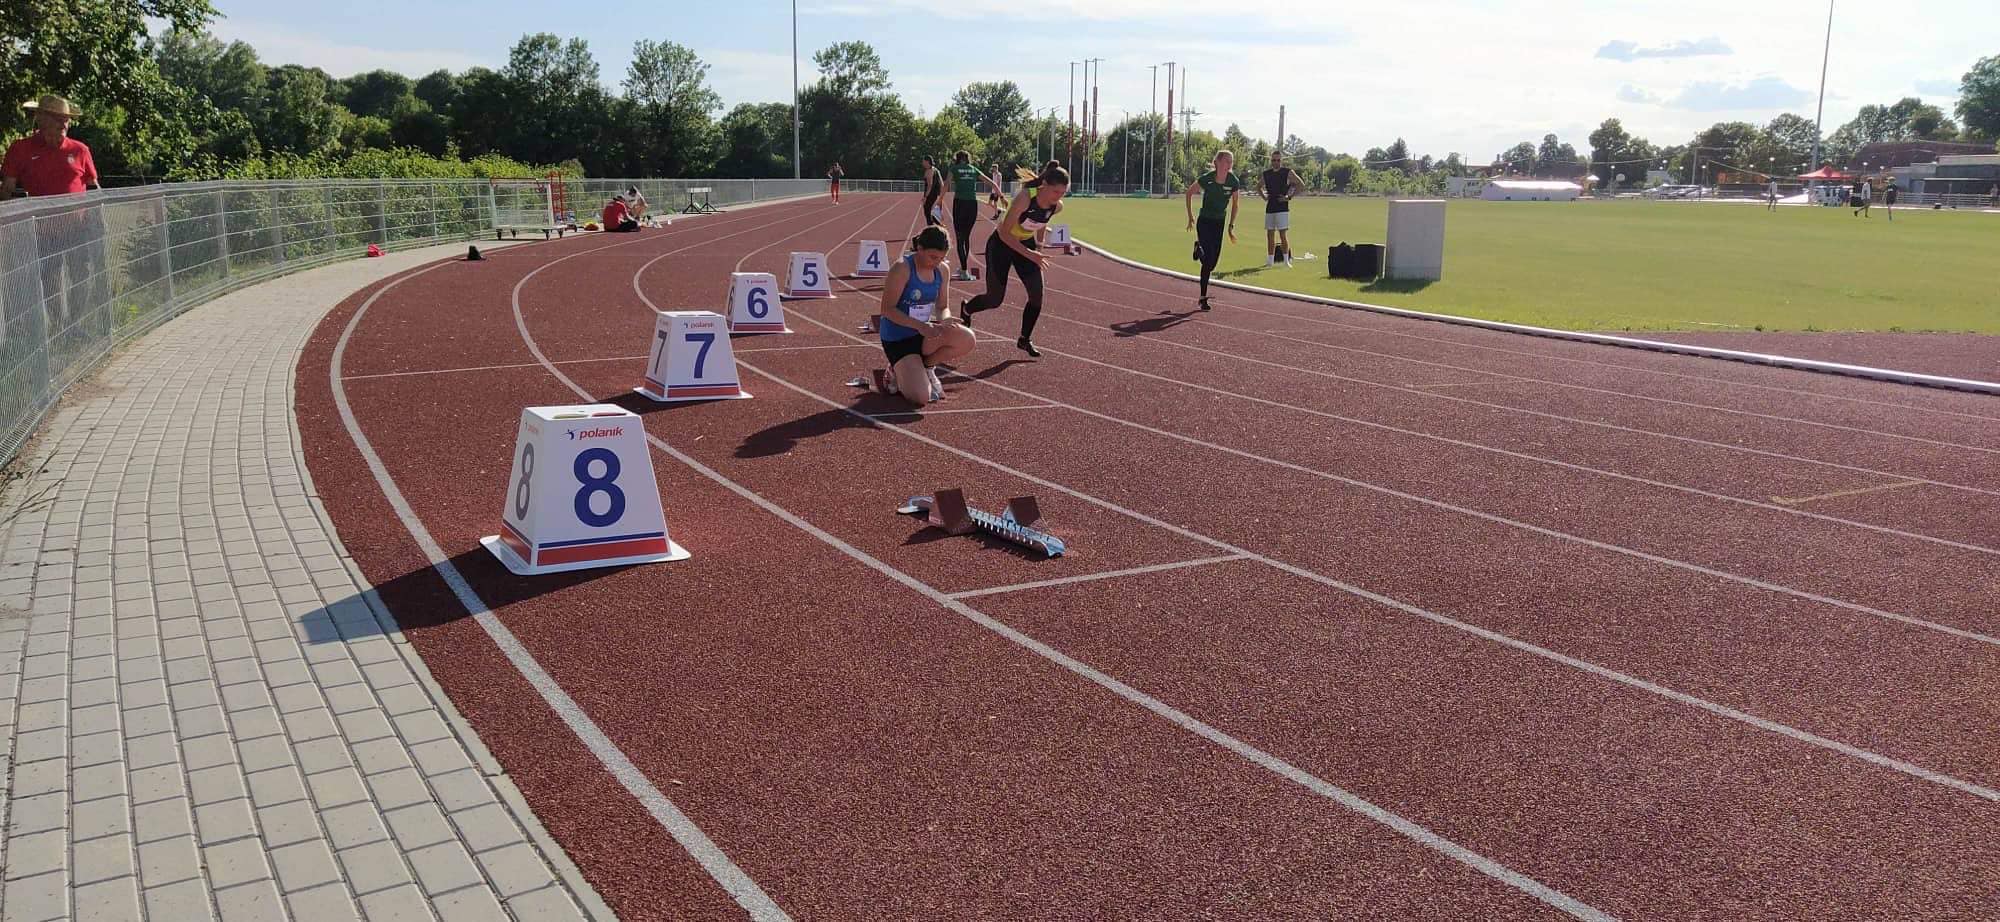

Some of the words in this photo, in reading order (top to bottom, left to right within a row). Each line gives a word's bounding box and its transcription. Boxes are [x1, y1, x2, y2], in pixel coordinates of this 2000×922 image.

[1057, 228, 1064, 242] 1
[802, 262, 819, 287] 5
[866, 249, 881, 269] 4
[747, 287, 769, 319] 6
[654, 329, 668, 375] 7
[685, 332, 715, 379] 7
[579, 426, 625, 441] polanik
[515, 442, 535, 521] 8
[573, 447, 626, 528] 8
